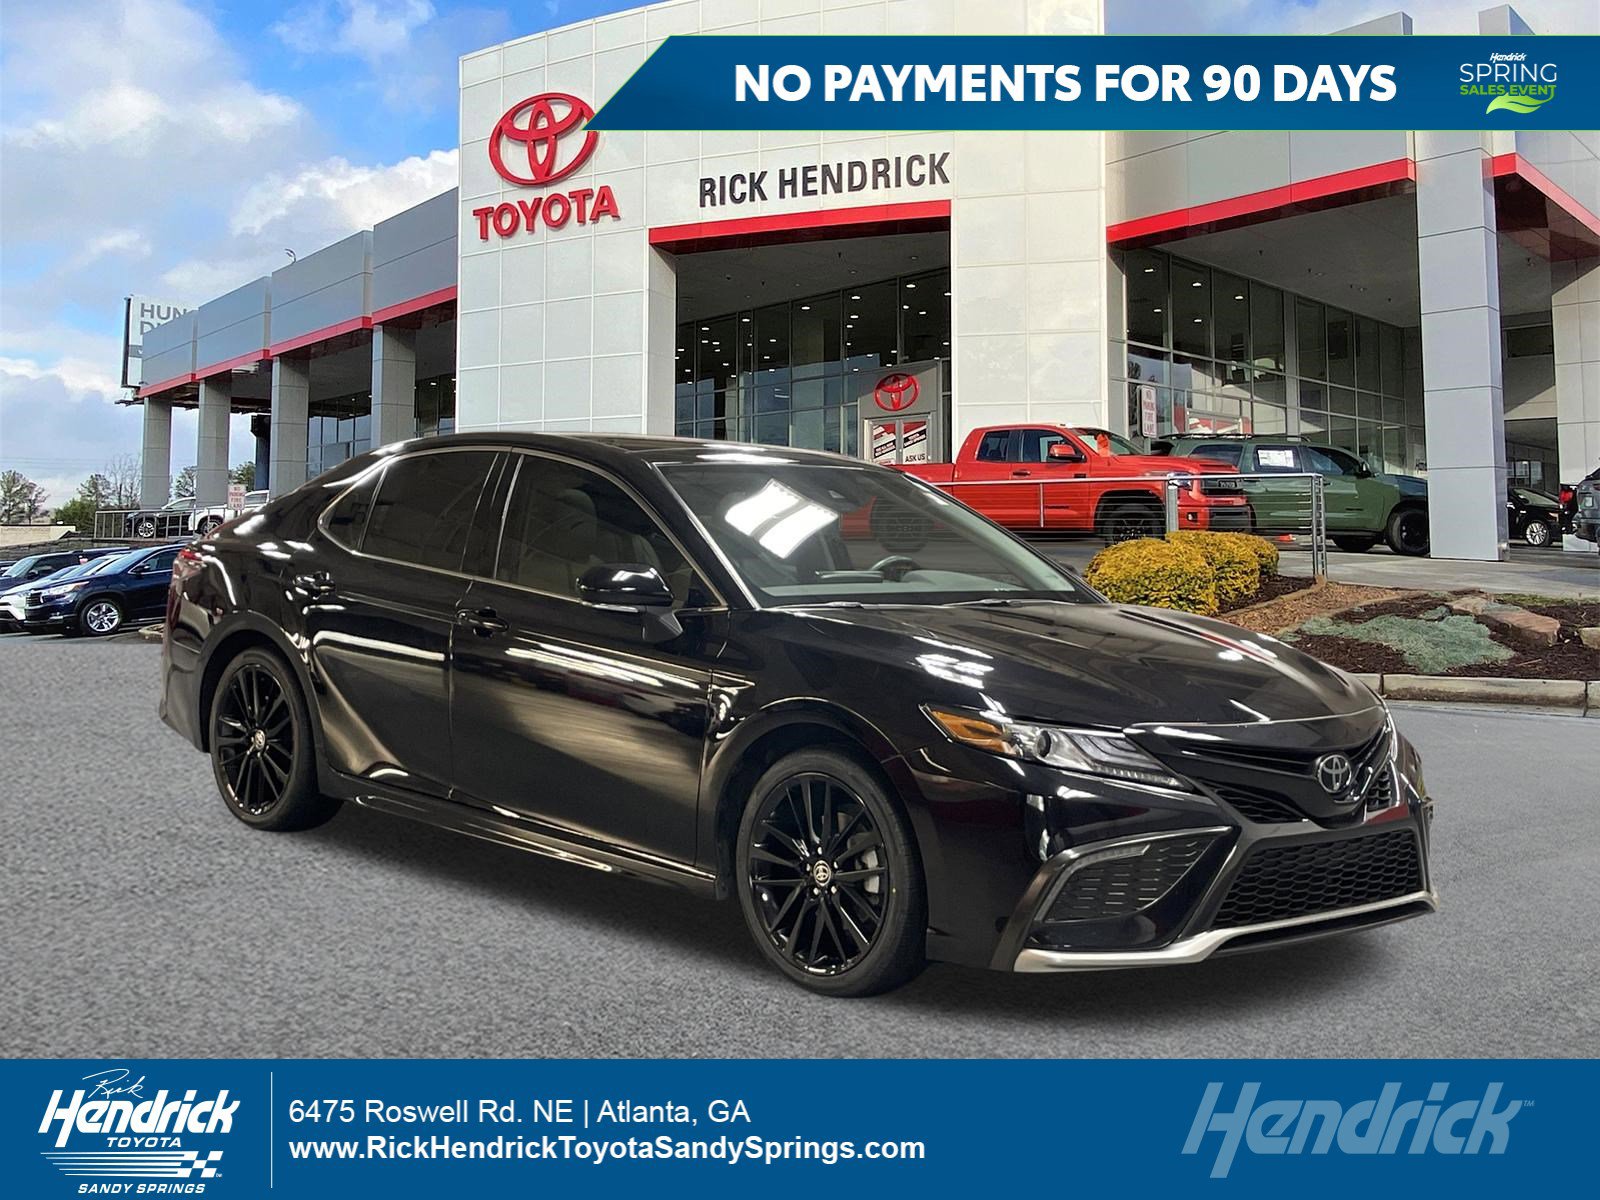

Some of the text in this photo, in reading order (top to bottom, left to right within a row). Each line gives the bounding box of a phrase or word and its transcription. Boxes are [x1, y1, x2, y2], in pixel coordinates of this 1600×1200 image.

[699, 152, 951, 208] RICK HENDRICK
[472, 184, 621, 241] TOYOTA
